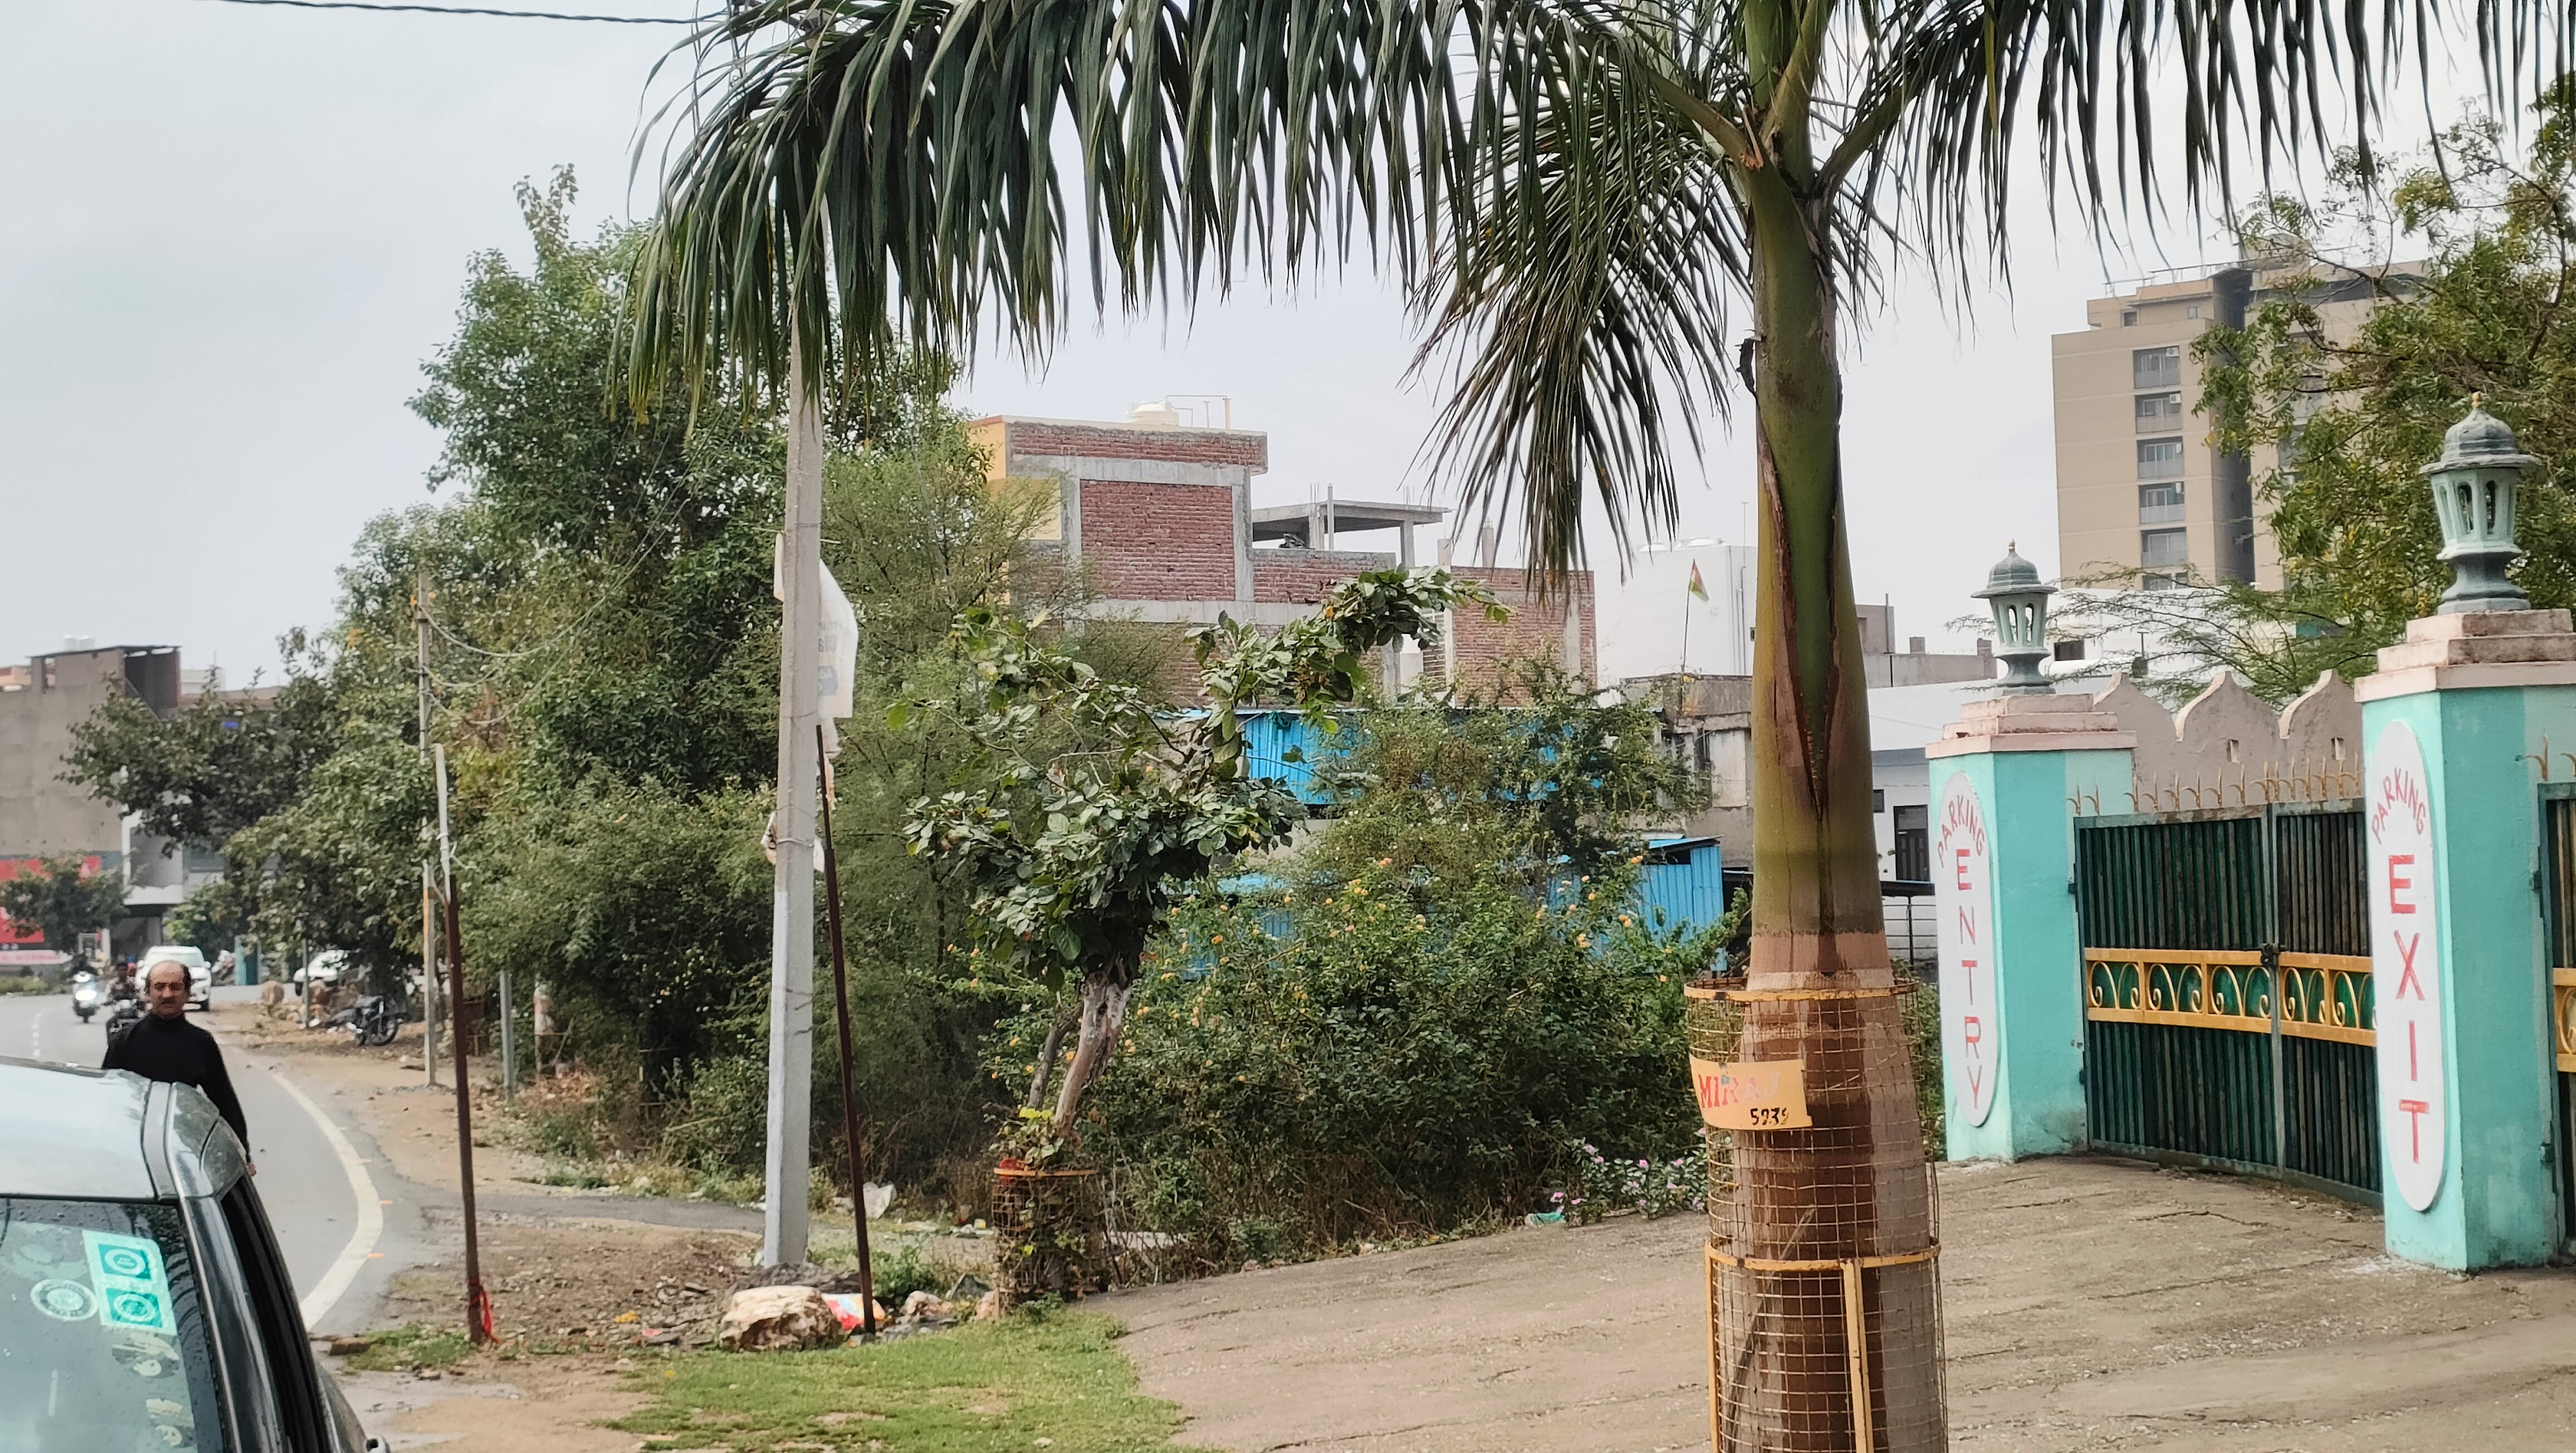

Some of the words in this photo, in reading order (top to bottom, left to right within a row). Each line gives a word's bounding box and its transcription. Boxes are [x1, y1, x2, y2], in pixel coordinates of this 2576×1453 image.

[1938, 796, 1986, 867] PARKING
[2372, 768, 2426, 844] PARKING
[1956, 849, 1982, 1110] ENTRY
[2388, 854, 2430, 1164] EXIT
[1698, 1072, 1781, 1108] MIRAJ
